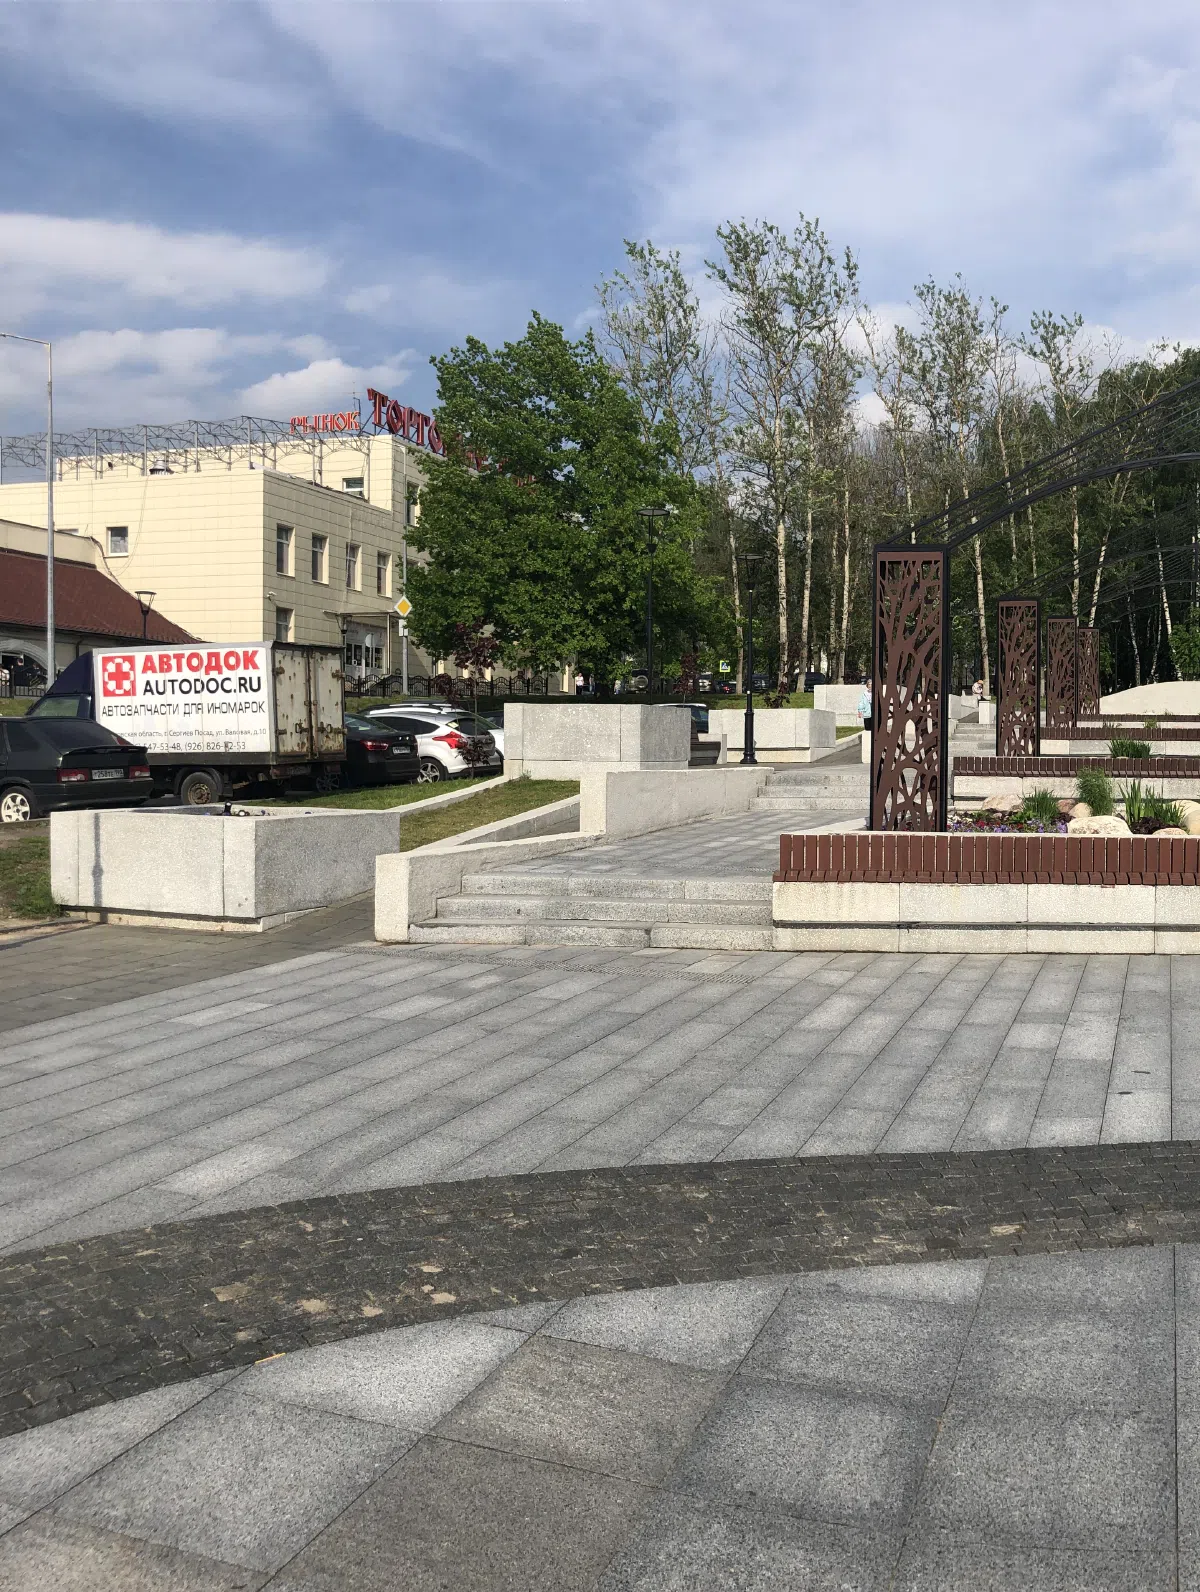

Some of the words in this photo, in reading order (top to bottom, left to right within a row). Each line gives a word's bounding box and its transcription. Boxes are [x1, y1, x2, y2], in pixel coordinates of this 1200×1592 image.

[289, 411, 360, 434] РЫНОК
[141, 649, 261, 676] АВТОДОК
[143, 676, 262, 696] AUTODOC.RU
[102, 703, 179, 716] АВТОЗАПЧАСТИ
[183, 702, 204, 717] ДЛЯ
[207, 700, 266, 715] ИНОМАРОК
[169, 729, 193, 737] Сергиев
